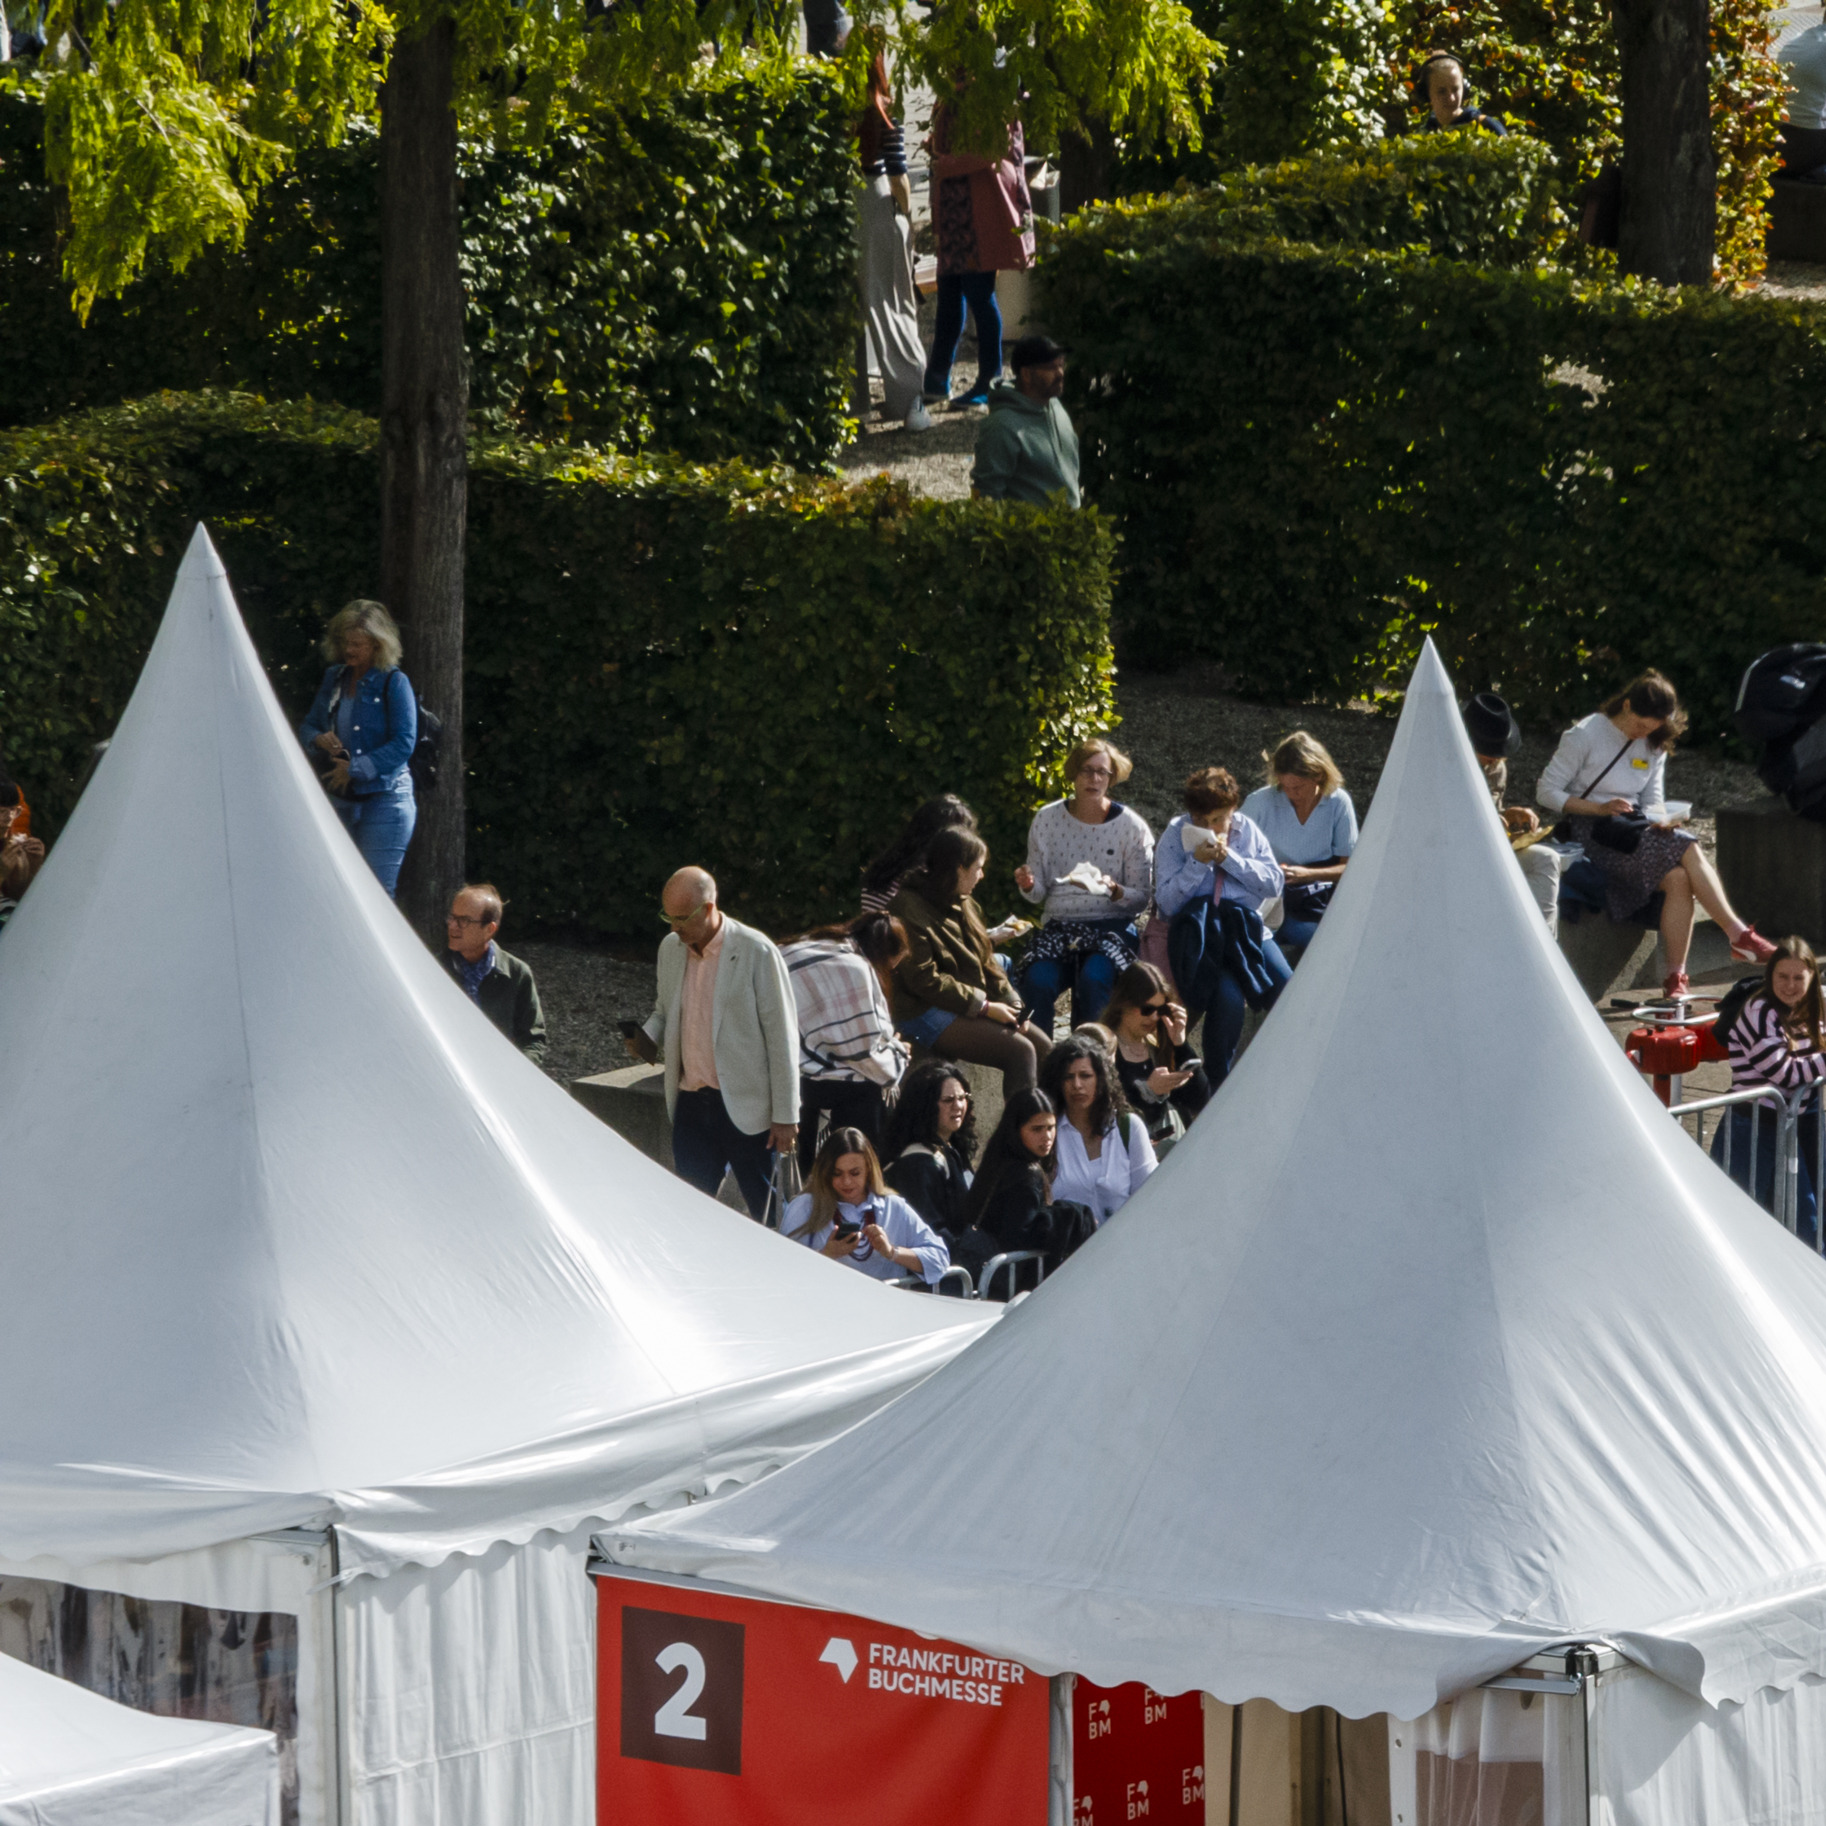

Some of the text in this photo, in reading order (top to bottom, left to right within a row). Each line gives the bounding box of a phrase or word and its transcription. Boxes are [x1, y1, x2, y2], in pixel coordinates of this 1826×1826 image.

[869, 1642, 1025, 1685] FRANKFURTER
[655, 1642, 706, 1740] 2
[868, 1670, 1003, 1706] BUCHMESSE
[1145, 1702, 1167, 1724] BM
[1089, 1718, 1111, 1739] BM
[1183, 1784, 1204, 1805] BM
[1127, 1799, 1149, 1820] BM
